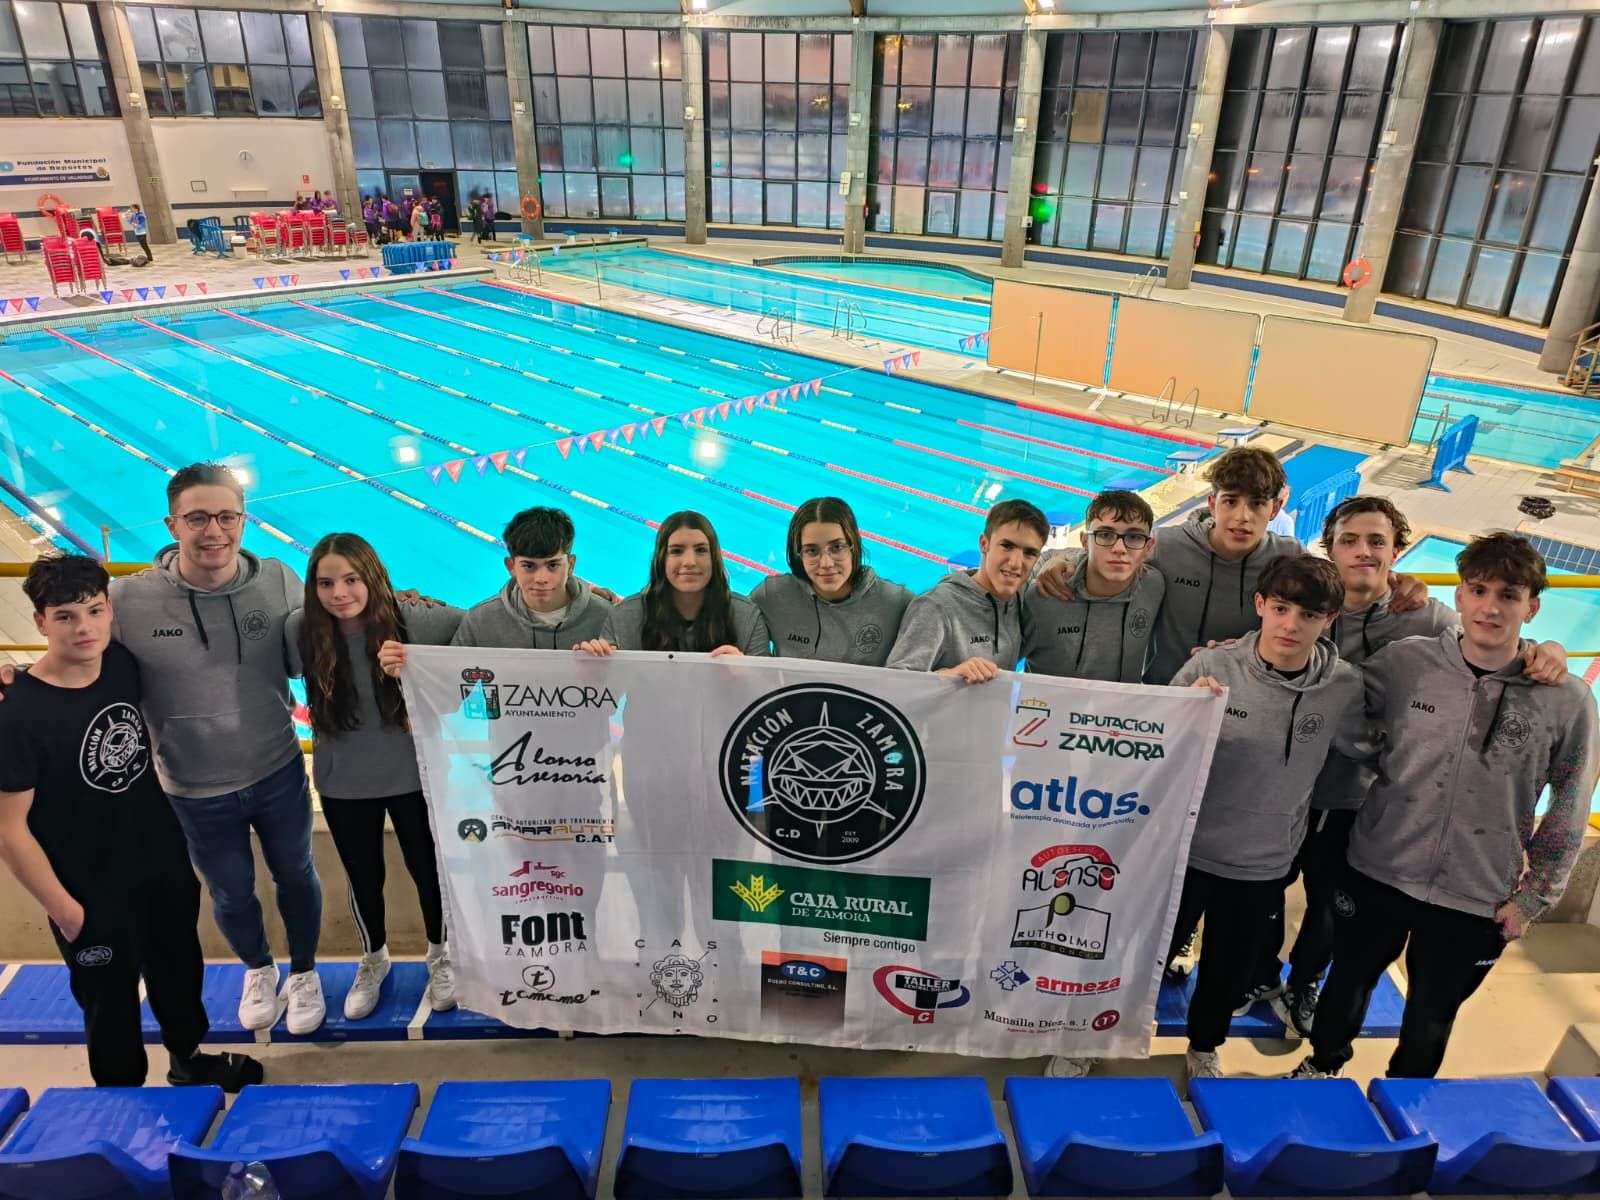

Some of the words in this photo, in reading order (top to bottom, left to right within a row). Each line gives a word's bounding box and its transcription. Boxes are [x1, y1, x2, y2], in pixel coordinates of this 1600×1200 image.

[1180, 463, 1187, 474] 2
[1174, 577, 1201, 588] JAKO
[152, 628, 184, 638] JAKO
[787, 632, 810, 645] JAKO
[1057, 626, 1081, 635] JAKO
[970, 636, 990, 644] JAKO
[502, 684, 619, 709] ZAMORA
[504, 710, 577, 719] AYUNTAMIENTO
[1224, 706, 1248, 719] AKO
[1410, 700, 1436, 714] JAKO
[472, 730, 597, 772] Alonso
[740, 707, 794, 786] NATACIÓN
[856, 712, 905, 791] ZAMORA
[1058, 732, 1166, 761] ZAMORA
[1010, 776, 1150, 820] atlas.
[841, 836, 860, 844] 2009
[492, 880, 584, 899] sangregorio
[790, 891, 839, 910] CAJA
[844, 896, 914, 917] RURAL
[792, 906, 810, 918] DE
[815, 908, 872, 923] ZAMORA
[501, 910, 588, 946] Font
[503, 941, 588, 958] ZAMORA
[823, 931, 871, 948] Siempre
[873, 939, 916, 954] contigo
[786, 964, 821, 978] T&C
[904, 976, 951, 989] TALLER
[1035, 975, 1121, 993] armeza
[983, 1010, 1035, 1028] Mansilla
